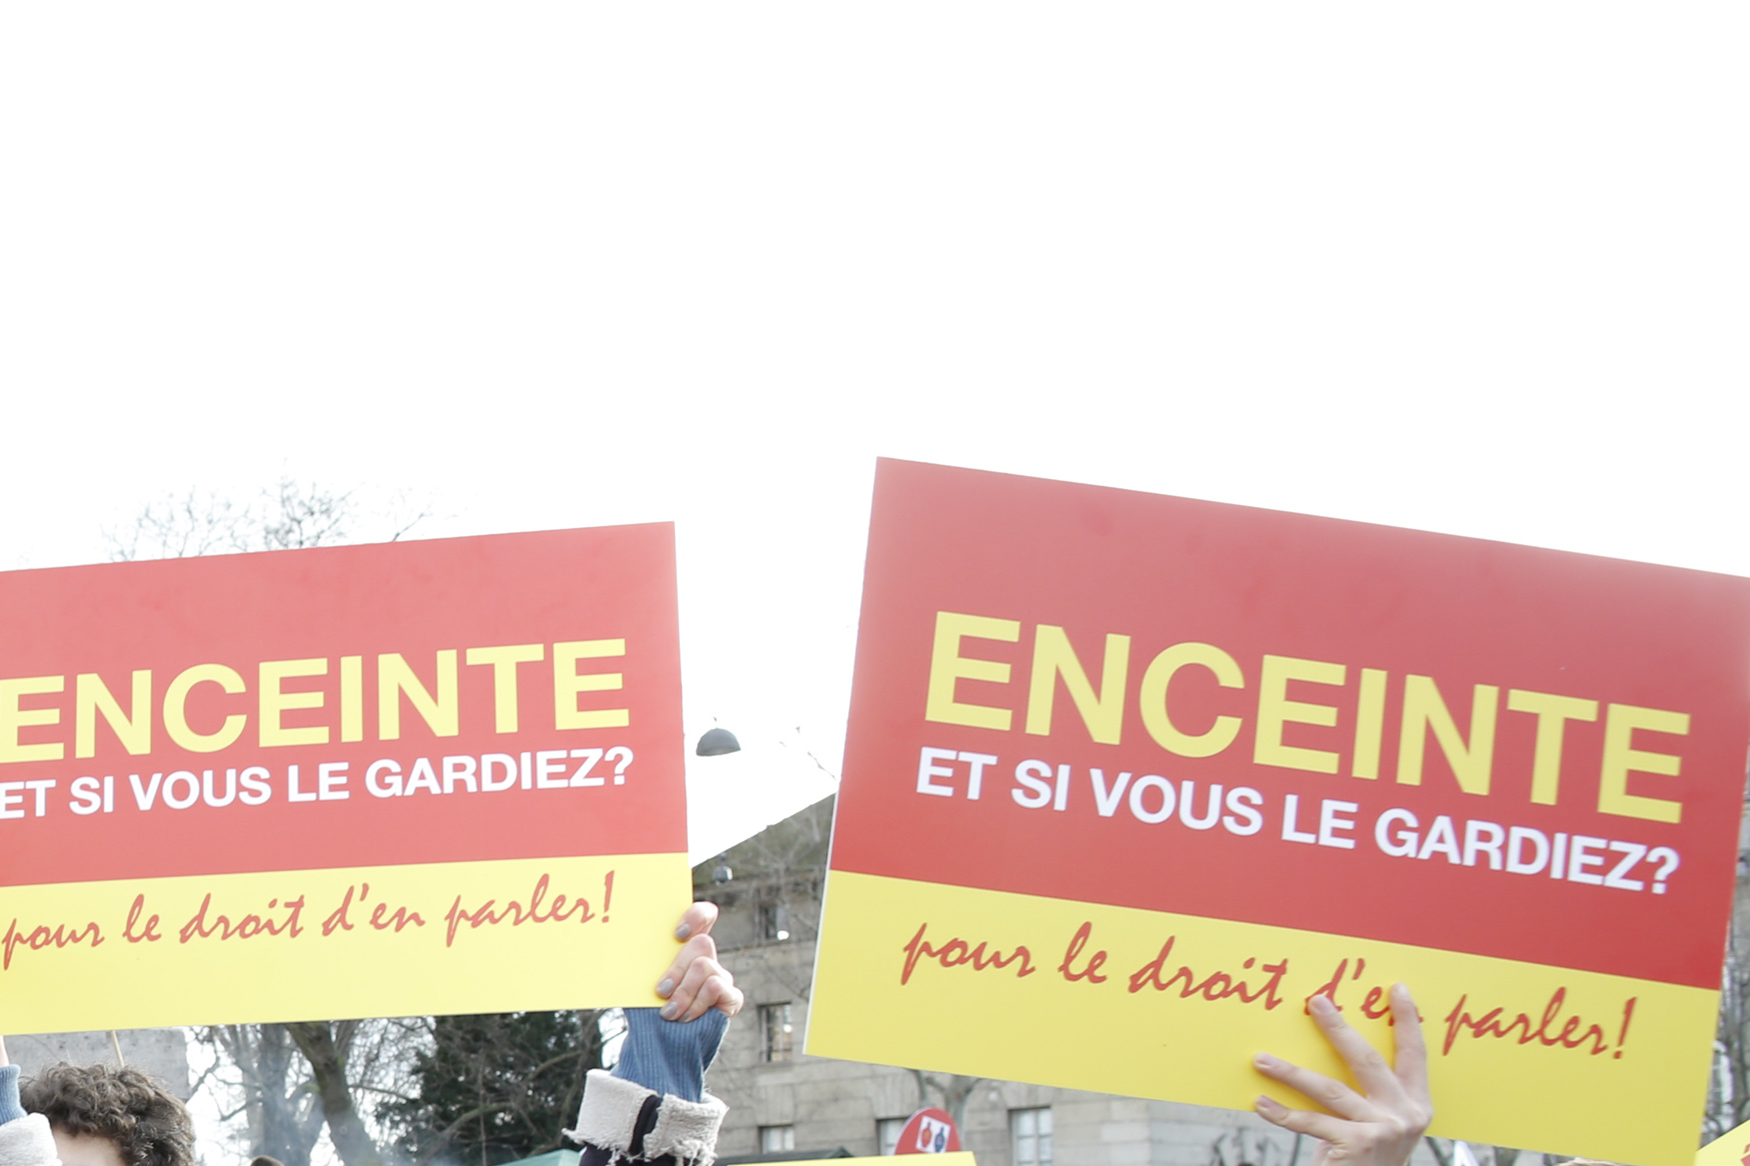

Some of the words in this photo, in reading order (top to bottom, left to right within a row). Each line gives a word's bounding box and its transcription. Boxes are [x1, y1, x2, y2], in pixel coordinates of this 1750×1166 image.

[68, 775, 114, 815] SI
[130, 765, 271, 811] VOUS
[287, 761, 350, 802] LE
[365, 746, 634, 798] GARDIEZ?
[924, 611, 1690, 824] ENCEINTE
[916, 747, 997, 800] ET
[1011, 759, 1069, 812] SI
[1089, 768, 1263, 836] VOUS
[1282, 793, 1358, 849] LE
[1374, 807, 1681, 895] GARDIEZ?
[1, 917, 105, 970] pour
[122, 894, 162, 943] le
[179, 892, 305, 944] droit
[322, 883, 425, 933] d'en
[445, 870, 616, 946] parler!
[901, 922, 1036, 985] pour
[1058, 921, 1108, 984] le
[1128, 936, 1289, 1010] droit
[1443, 986, 1637, 1059] parler!
